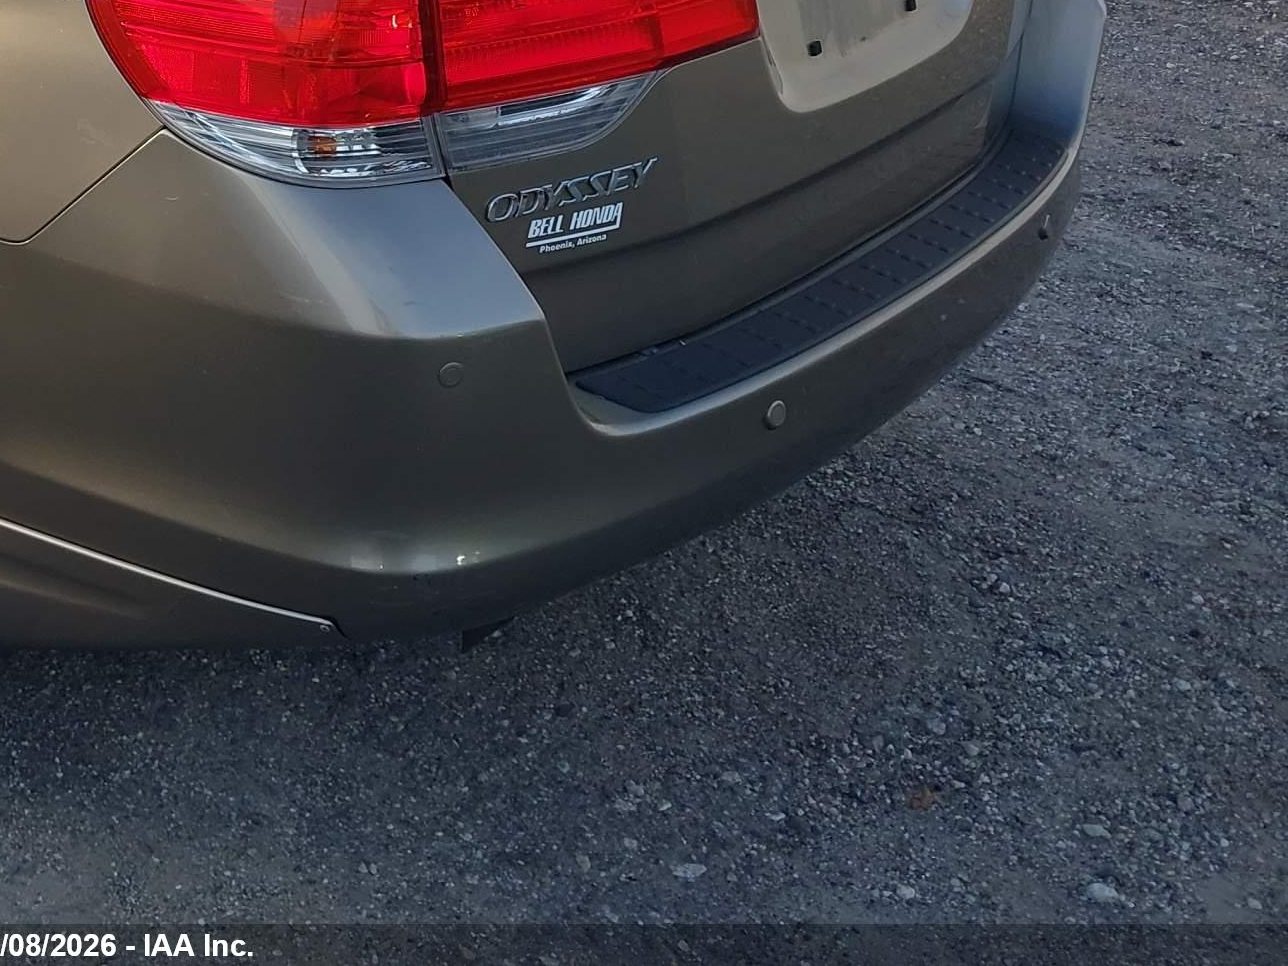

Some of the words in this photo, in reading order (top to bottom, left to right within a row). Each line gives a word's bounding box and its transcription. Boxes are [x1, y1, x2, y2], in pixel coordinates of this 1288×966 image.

[487, 157, 658, 222] ODYSSEY
[527, 214, 564, 239] BELL
[569, 202, 624, 232] HONDA
[539, 241, 575, 254] Phoenix,
[577, 234, 607, 246] Arizona
